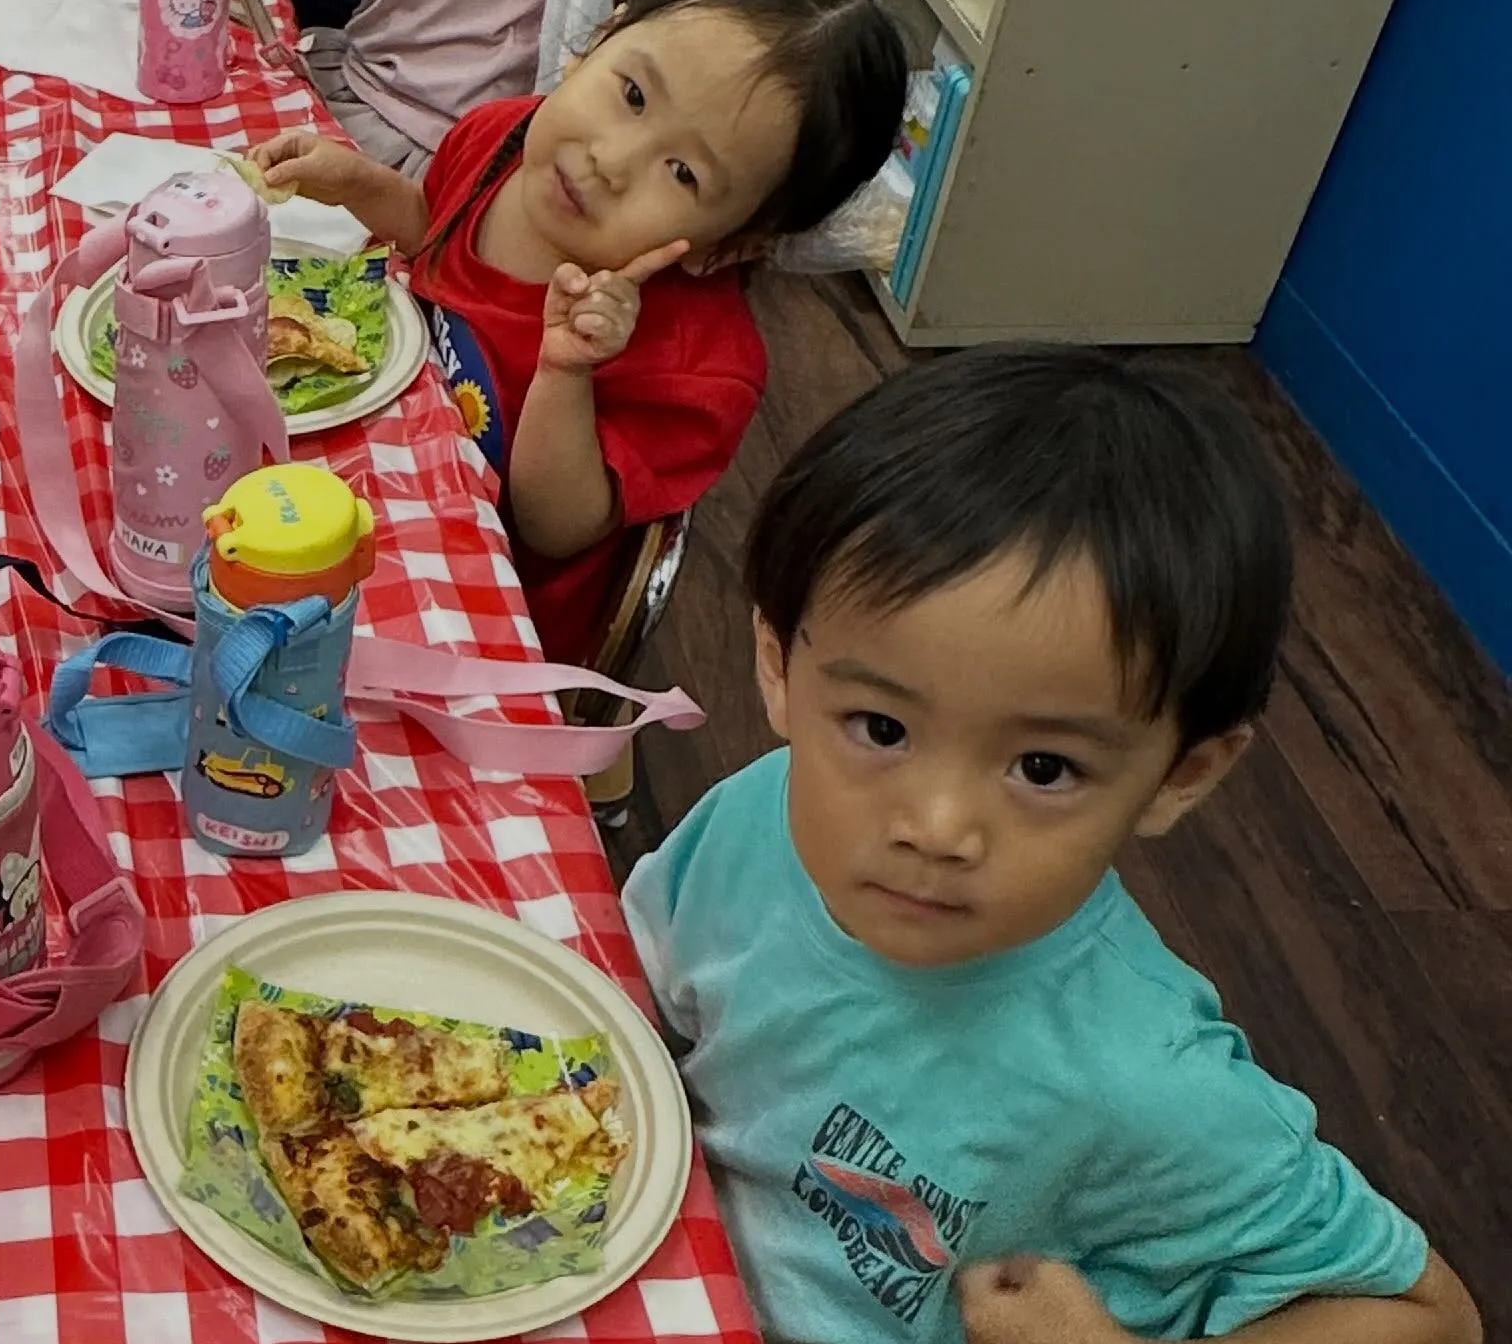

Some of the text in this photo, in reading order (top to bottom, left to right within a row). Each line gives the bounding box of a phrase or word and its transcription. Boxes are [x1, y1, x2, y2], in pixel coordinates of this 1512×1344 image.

[121, 526, 169, 561] HANA
[204, 818, 279, 847] KEISHI
[811, 1102, 907, 1180] GENTLE
